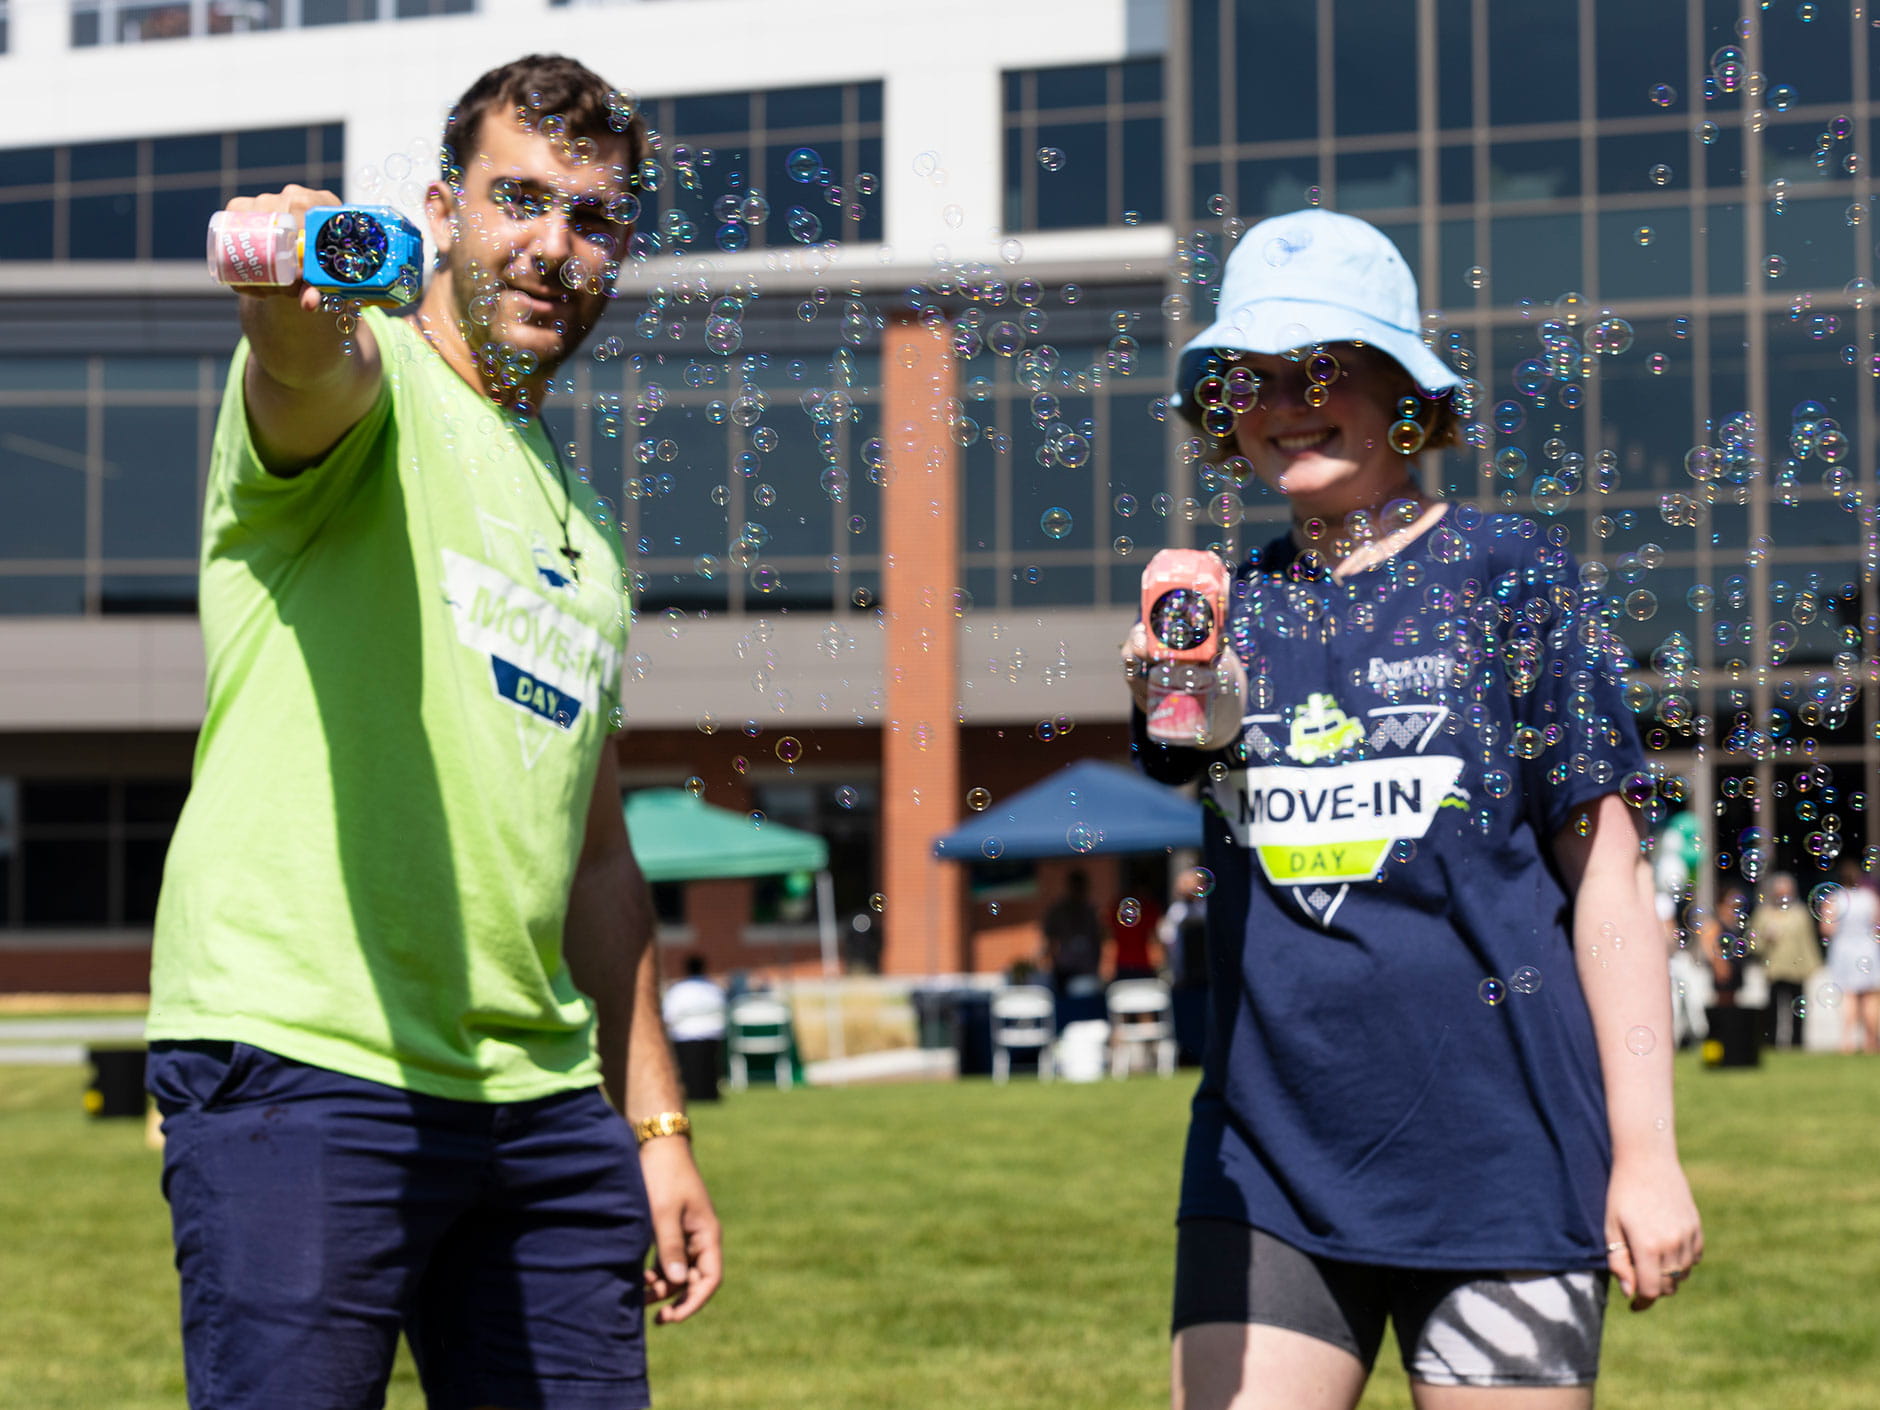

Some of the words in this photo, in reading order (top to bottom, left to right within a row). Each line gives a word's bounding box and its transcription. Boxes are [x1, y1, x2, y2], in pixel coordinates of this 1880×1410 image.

[238, 231, 264, 277] Bubble
[515, 676, 560, 716] DAY
[1237, 779, 1422, 825] MOVE-IN
[1289, 849, 1347, 873] DAY
